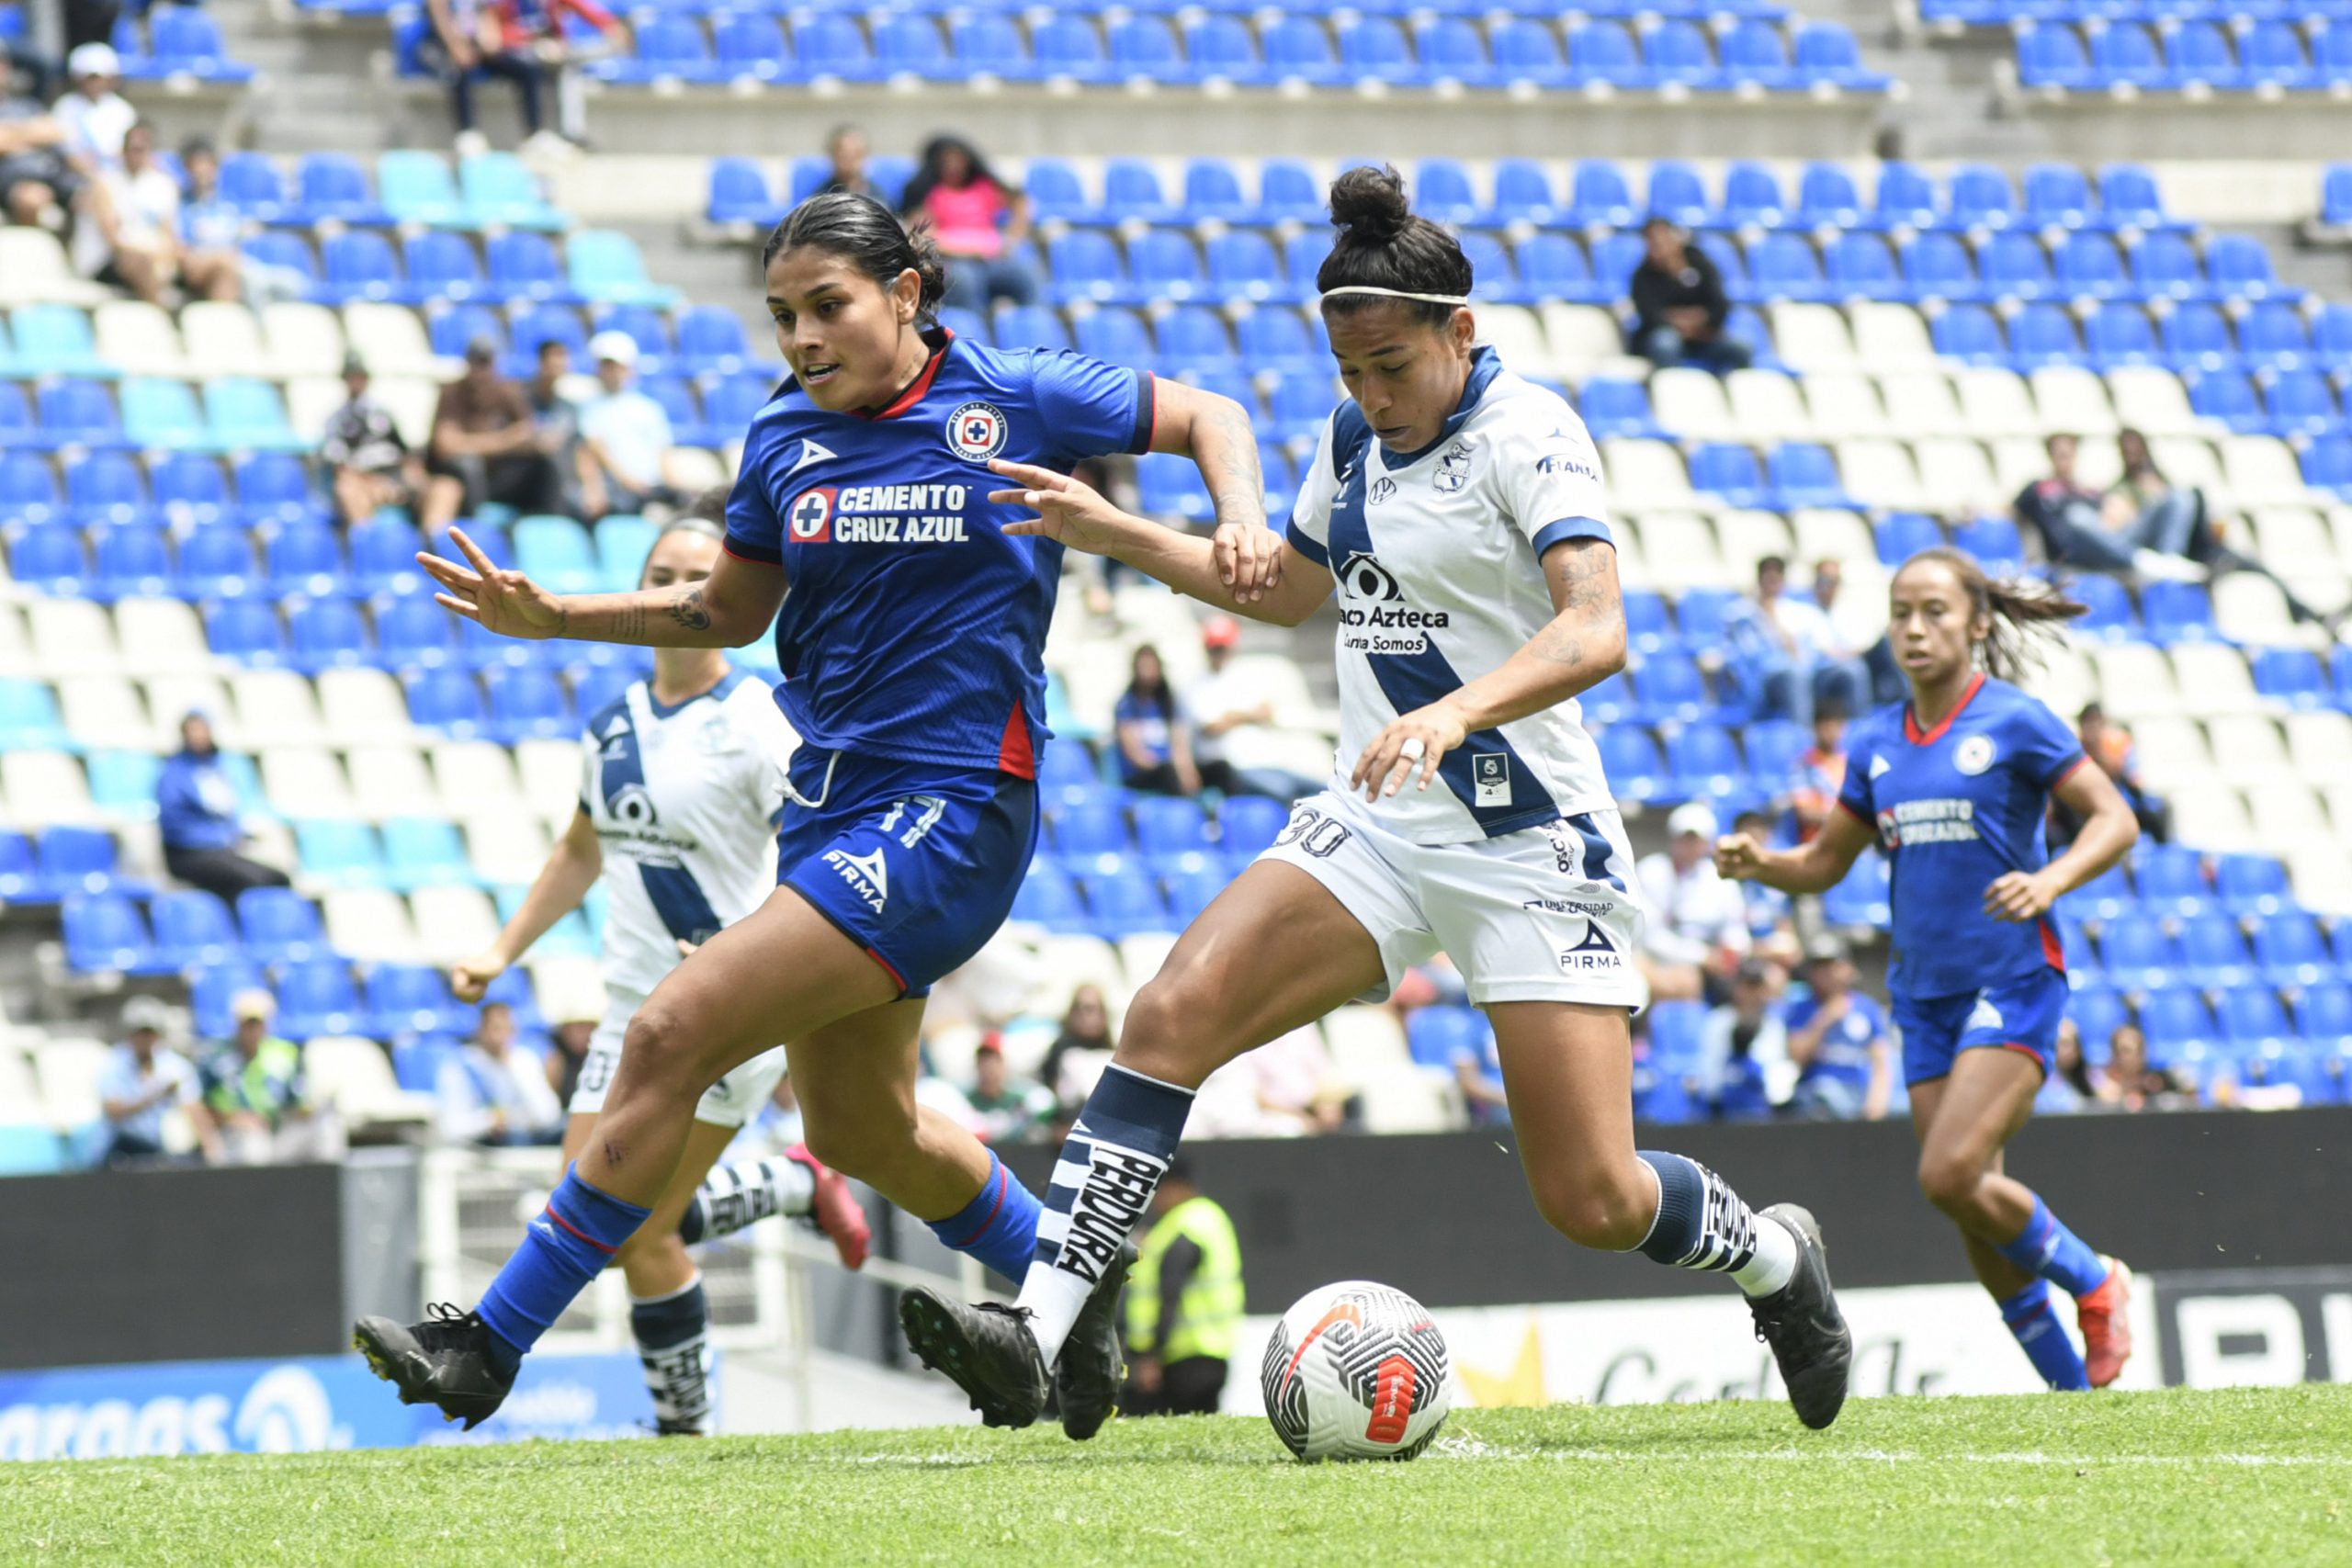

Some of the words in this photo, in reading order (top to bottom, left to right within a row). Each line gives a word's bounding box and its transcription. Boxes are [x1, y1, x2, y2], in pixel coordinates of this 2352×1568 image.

[838, 485, 966, 512] CEMENTO
[834, 517, 899, 543] CRUZ
[902, 516, 969, 543] AZUL
[1368, 605, 1449, 628] Azteca
[1373, 635, 1423, 651] Somos
[878, 795, 946, 850] 17
[821, 851, 887, 914] PIRMA
[1560, 955, 1622, 969] PIRMA
[1057, 1145, 1162, 1284] PERDURA
